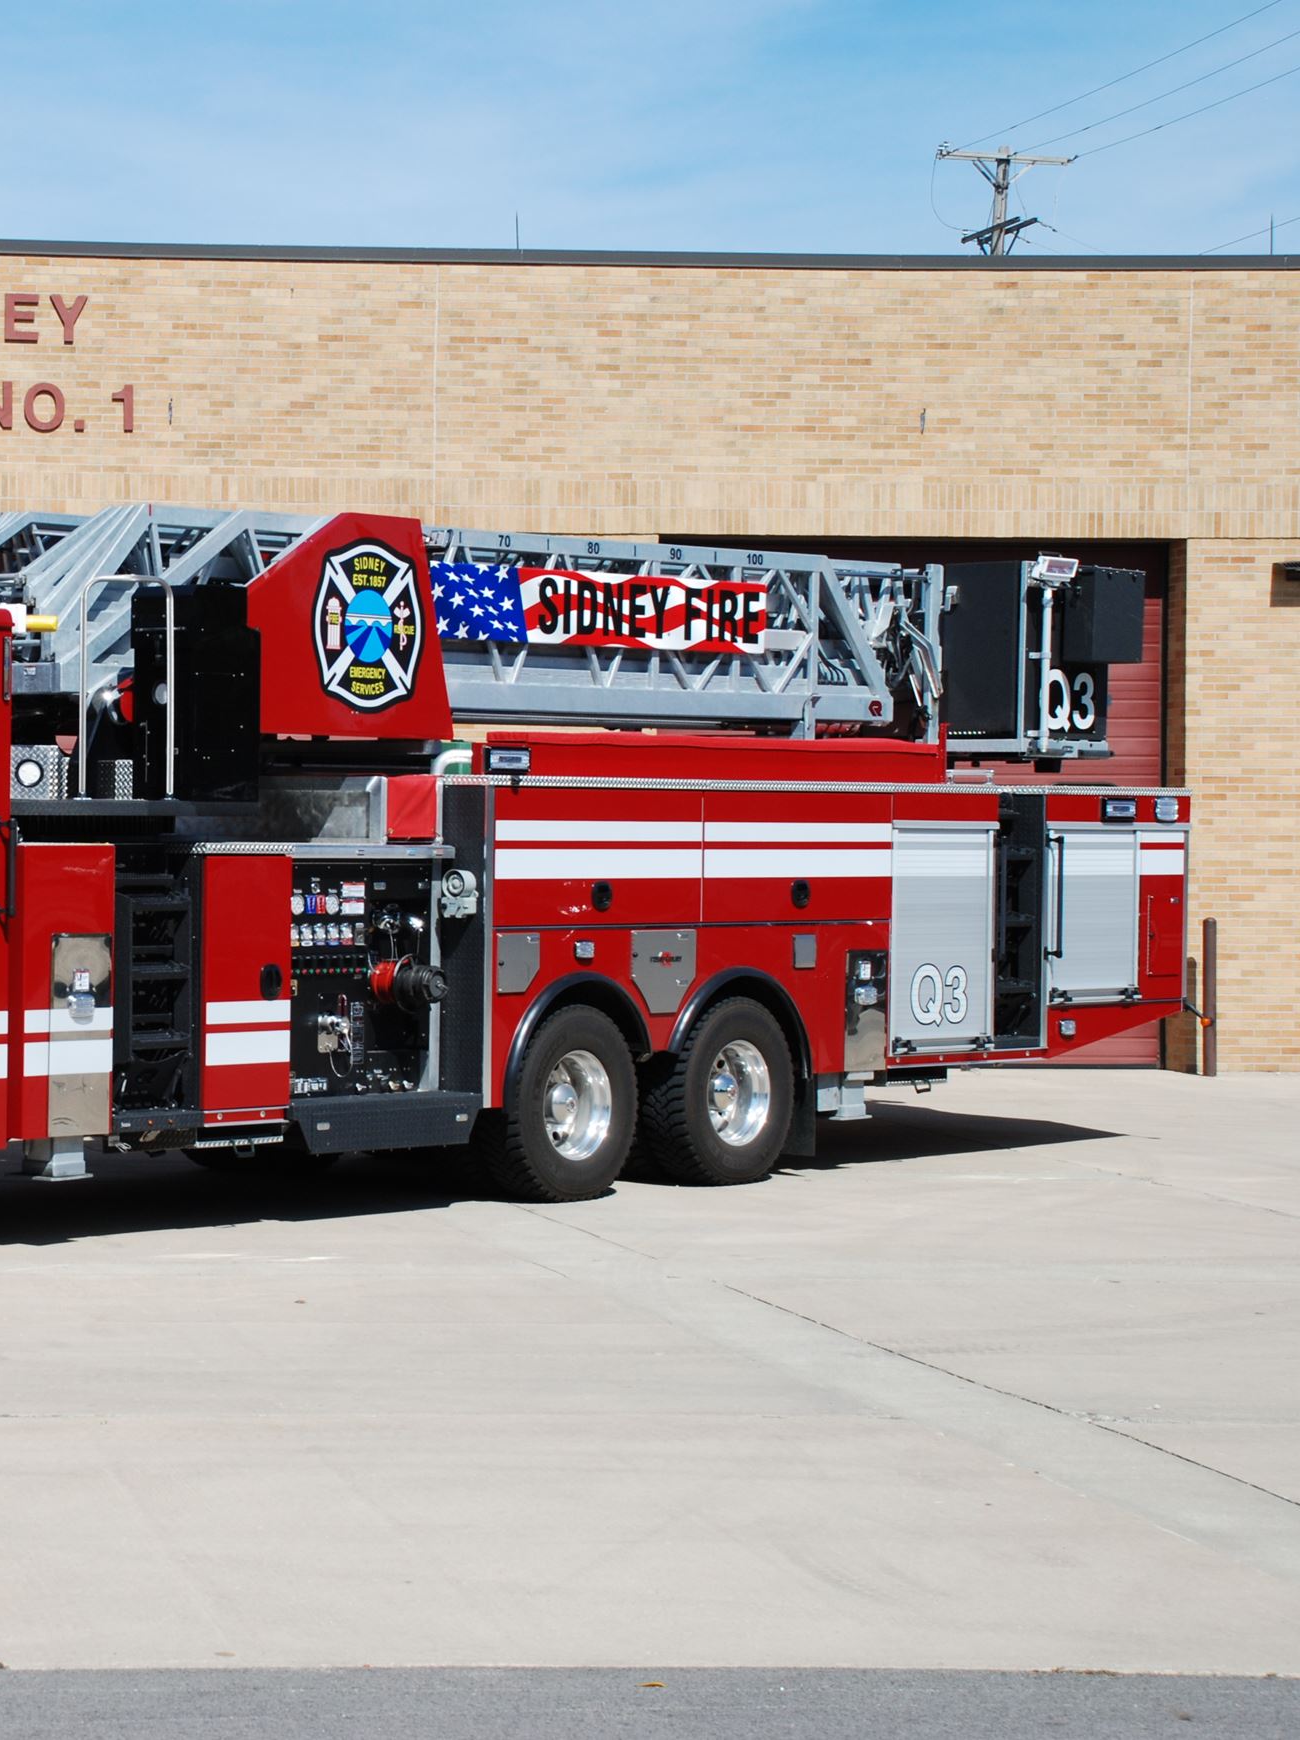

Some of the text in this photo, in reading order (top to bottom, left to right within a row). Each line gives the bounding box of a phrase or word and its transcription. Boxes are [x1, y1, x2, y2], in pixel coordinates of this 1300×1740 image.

[498, 534, 764, 566] 70 80 90 100
[354, 556, 386, 574] SIDNEY
[538, 576, 760, 645] SIDNEY FIRE
[394, 624, 415, 635] RCUE
[350, 665, 386, 680] EMERGENCY
[350, 680, 385, 696] SERVICES
[1039, 668, 1096, 733] Q3
[910, 962, 969, 1028] Q3
